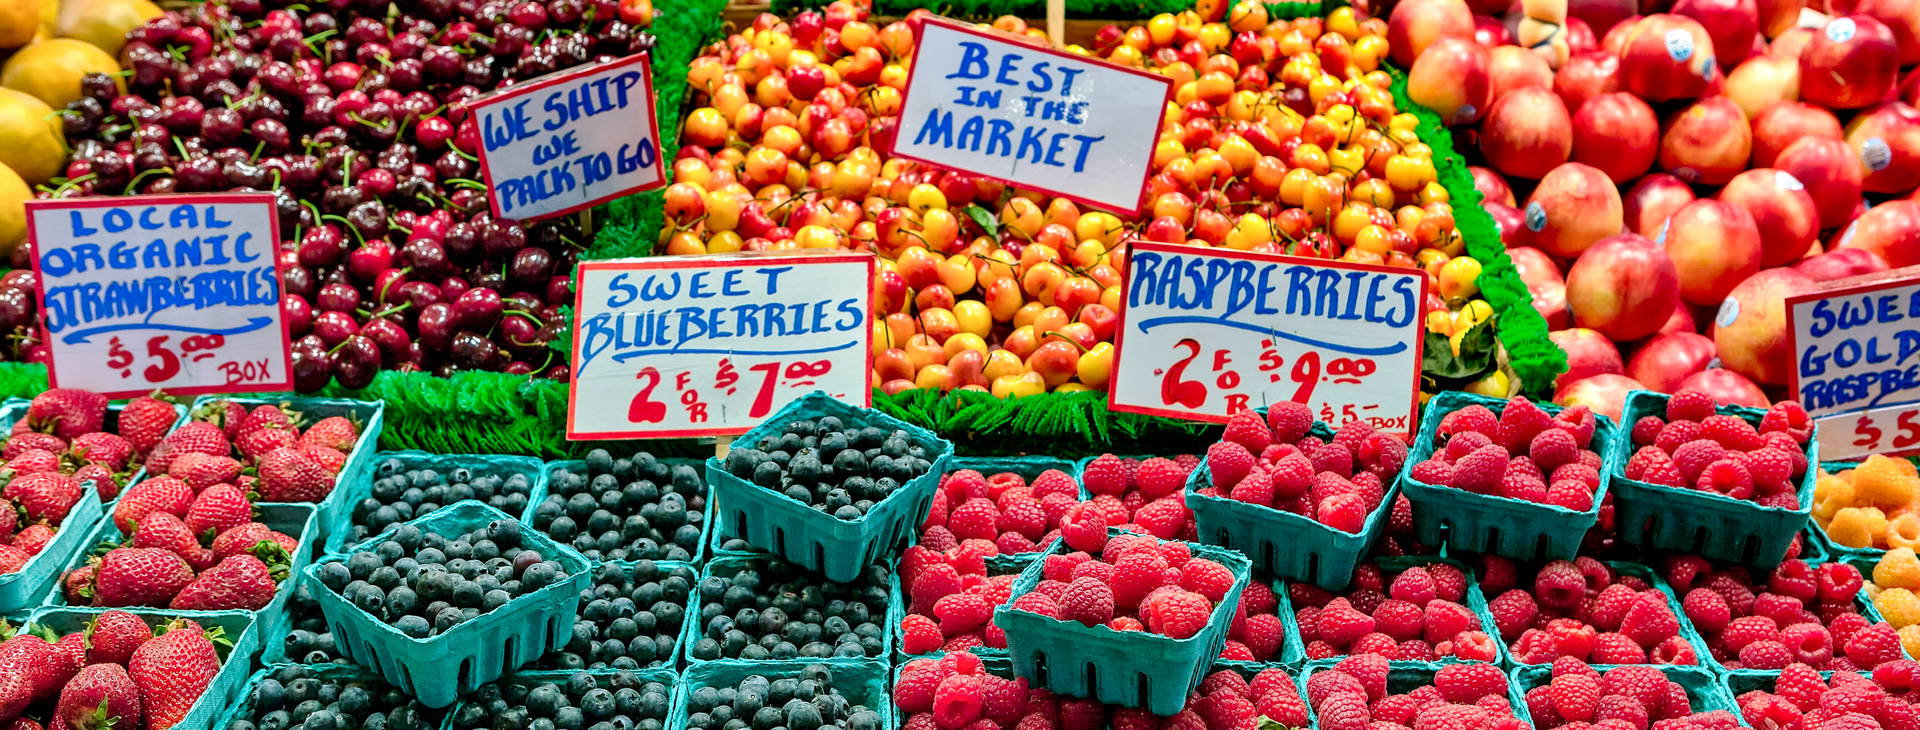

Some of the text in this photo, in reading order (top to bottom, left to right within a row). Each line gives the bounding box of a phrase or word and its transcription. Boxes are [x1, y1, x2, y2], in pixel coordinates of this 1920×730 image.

[945, 41, 1084, 96] BEST
[484, 71, 642, 152] WE SHIP
[953, 86, 1089, 125] IN THE
[532, 129, 581, 166] WE
[913, 108, 1105, 173] MARKET
[495, 137, 656, 213] PACK TO GO
[70, 204, 232, 238] LOCAL
[40, 231, 260, 277] ORGANIC
[44, 265, 279, 334] STRAWBERRIES
[607, 266, 793, 308] SWEET
[1129, 252, 1416, 328] RASPBERRIES
[576, 298, 864, 378] BLUEBERRIES
[1801, 329, 1920, 378] GOLD
[217, 358, 270, 385] BOX
[628, 366, 667, 423] 2
[675, 371, 708, 423] FOR
[1161, 338, 1207, 409] 2
[1365, 415, 1407, 430] BOX
